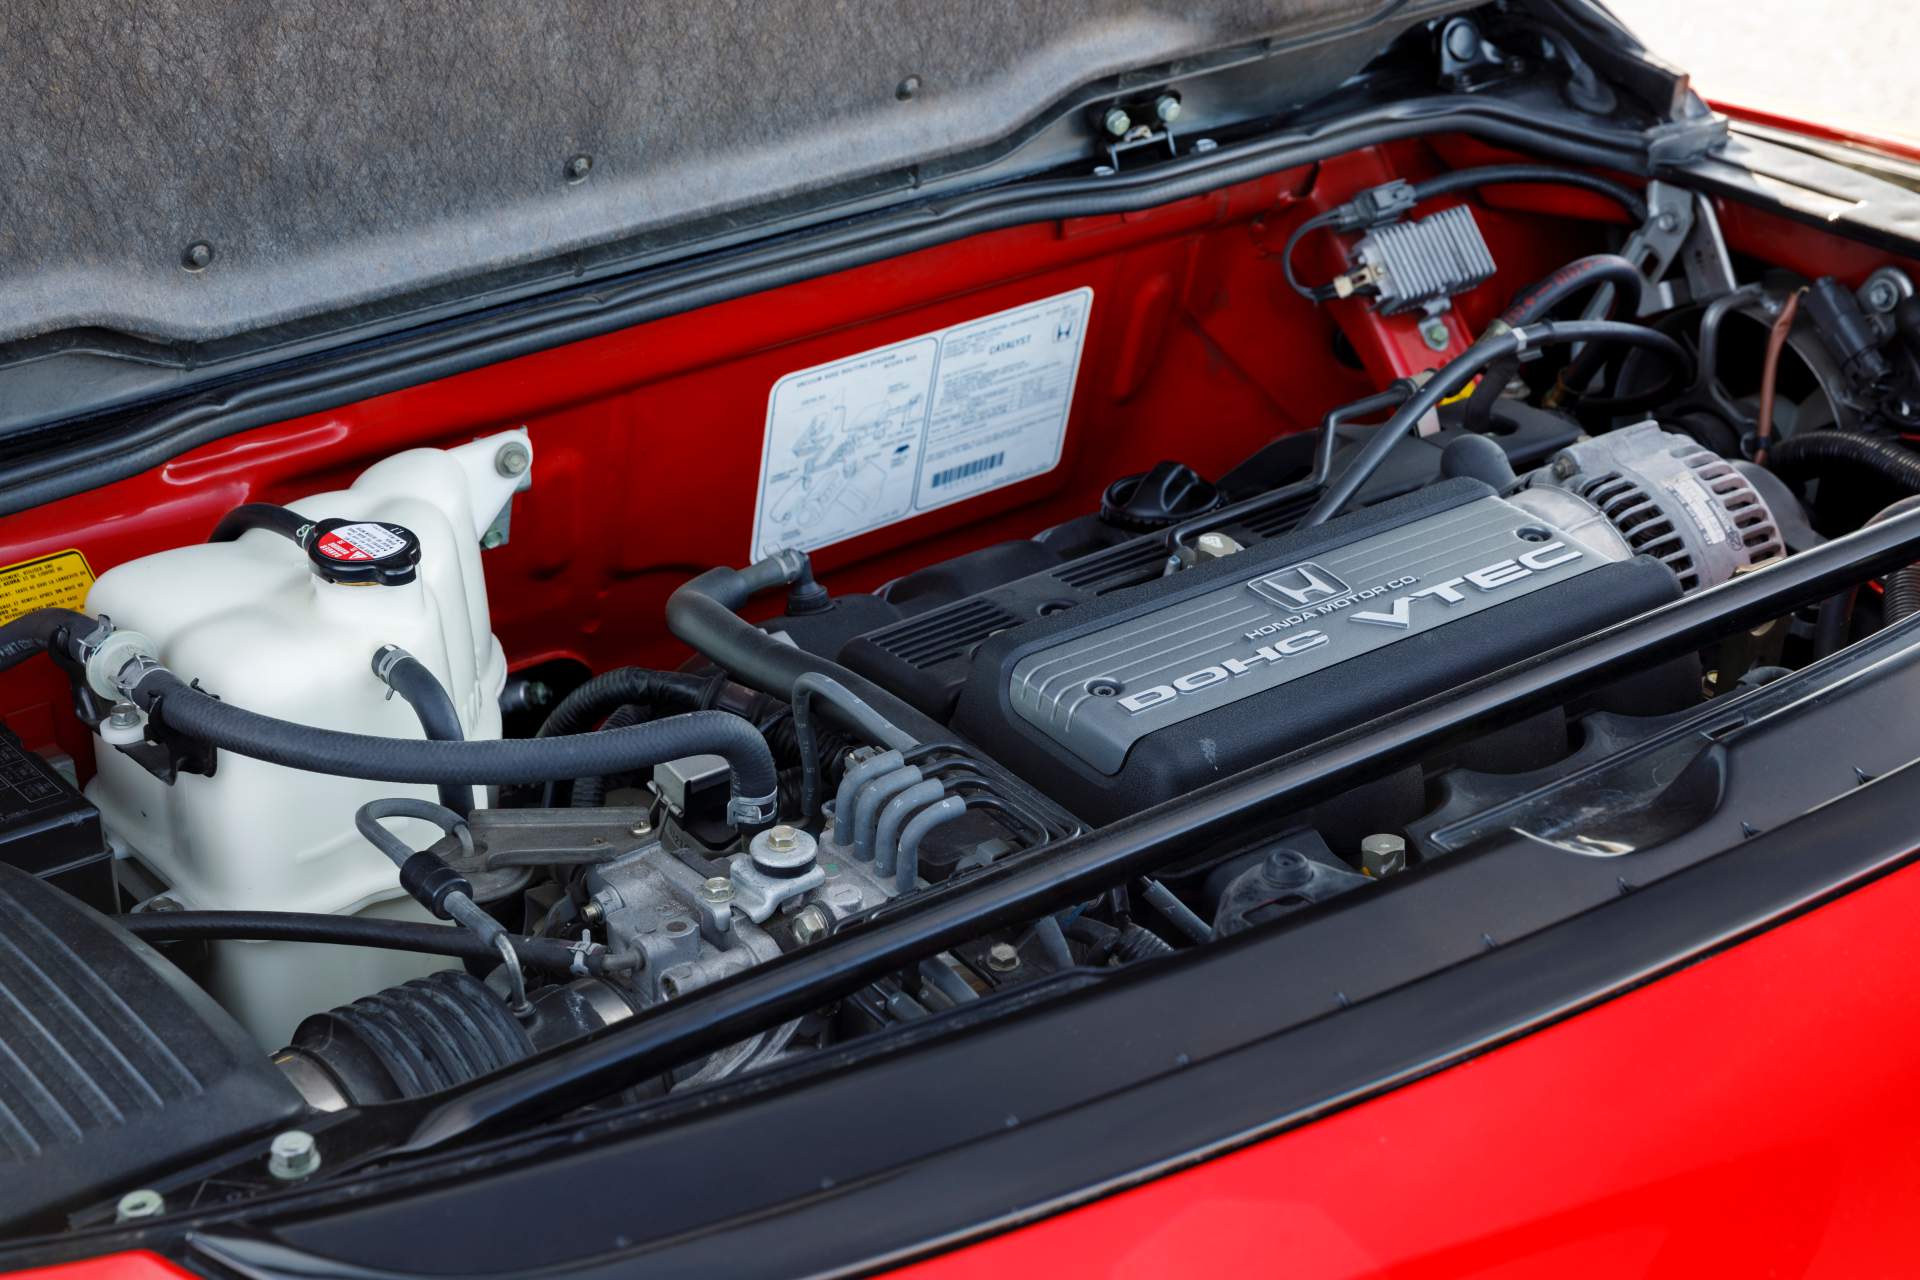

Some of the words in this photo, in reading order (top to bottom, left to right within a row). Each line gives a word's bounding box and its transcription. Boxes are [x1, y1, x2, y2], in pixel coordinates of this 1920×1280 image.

[989, 334, 1031, 355] CATALYST
[1117, 629, 1330, 715] DOHC
[1349, 541, 1584, 628] VTEC
[1244, 611, 1318, 641] HONDA
[1317, 585, 1388, 614] MOTOR
[1386, 575, 1421, 591] CO.
